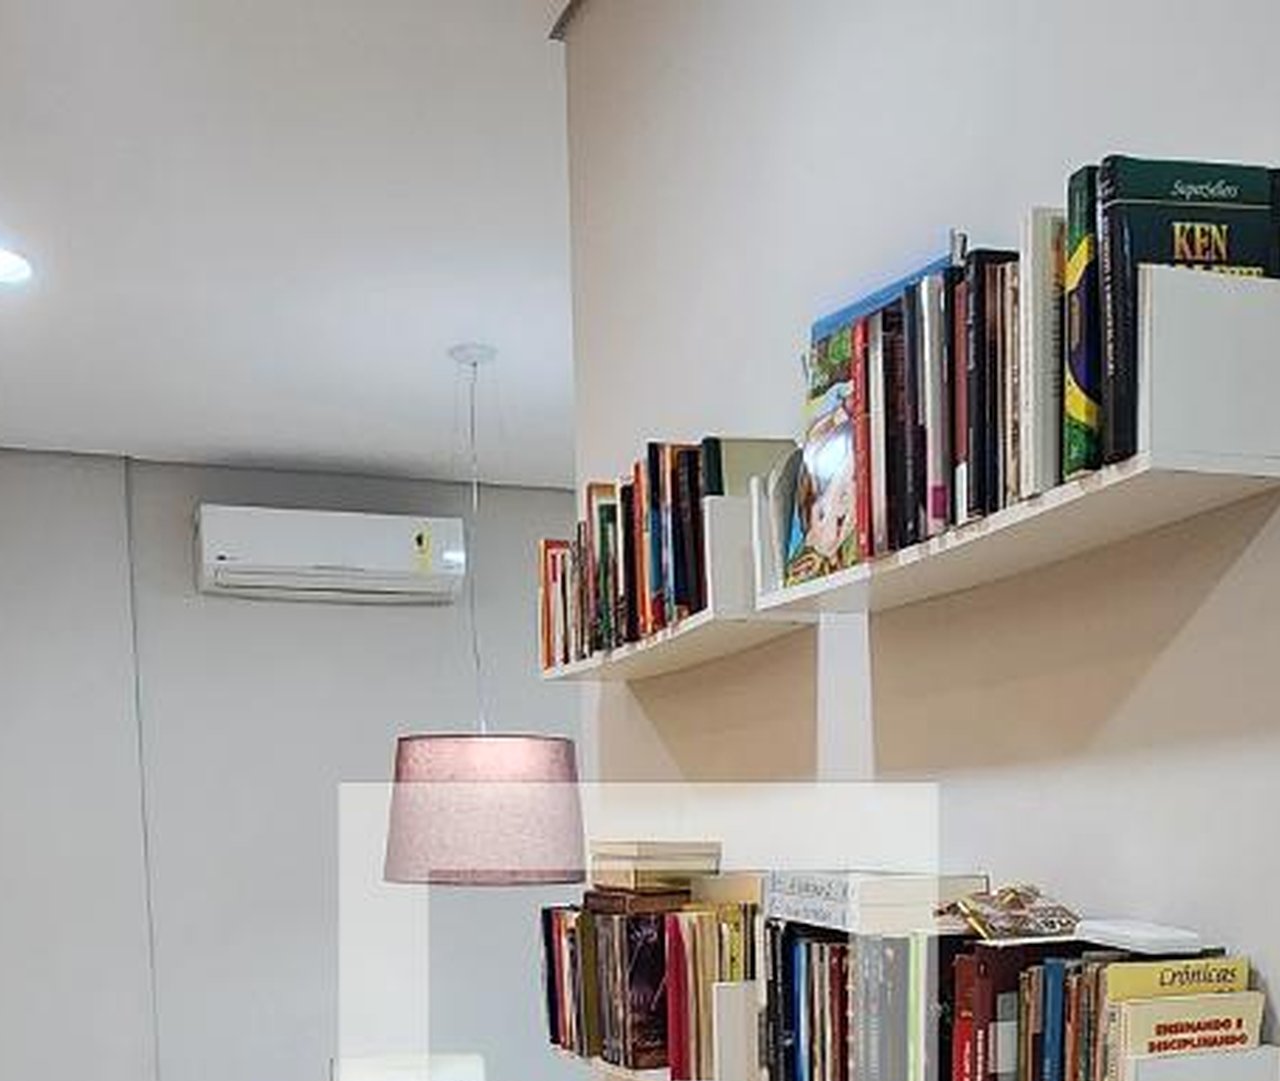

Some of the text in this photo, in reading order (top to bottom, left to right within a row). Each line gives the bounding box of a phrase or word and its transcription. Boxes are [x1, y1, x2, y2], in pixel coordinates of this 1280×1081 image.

[1171, 221, 1229, 261] KEN
[1155, 1018, 1232, 1036] ENSINANDO
[1147, 1032, 1248, 1053] DISCIPLINANDO
